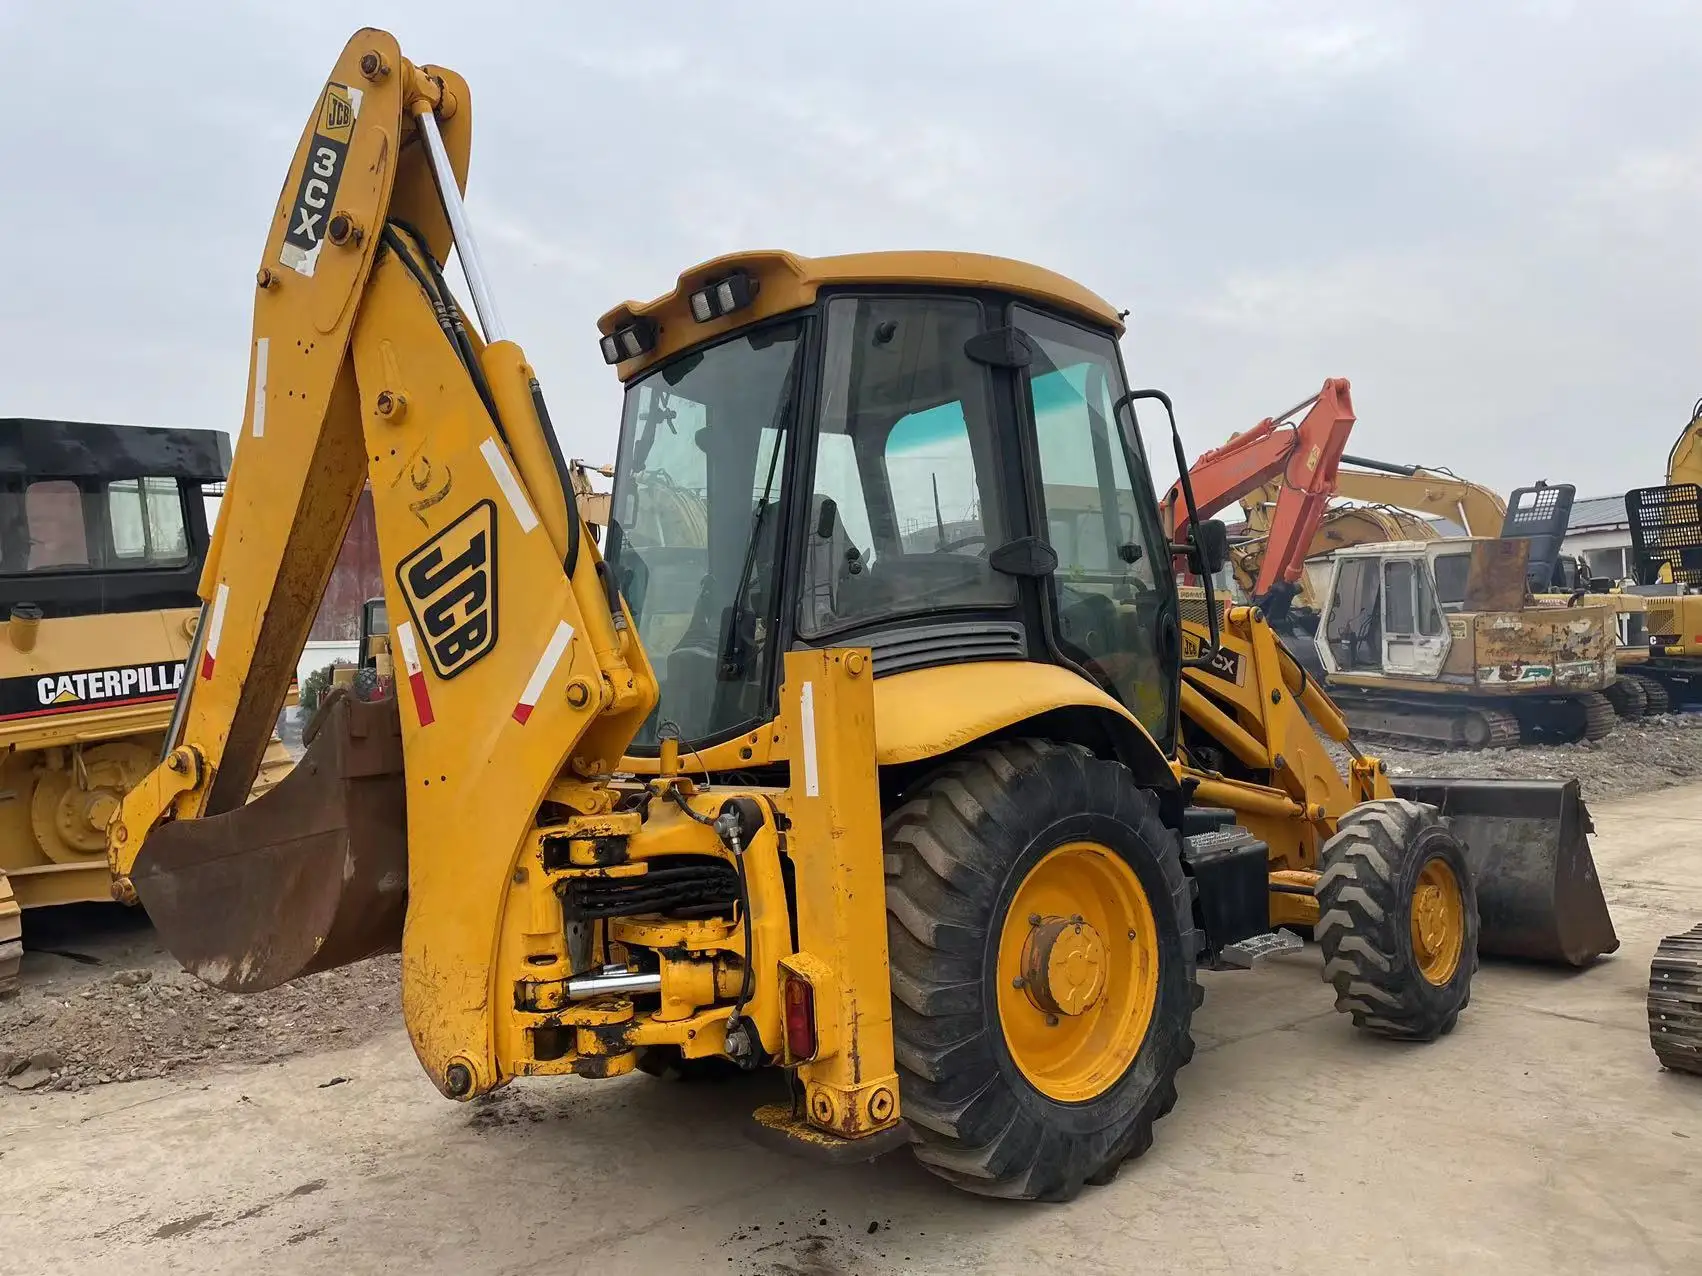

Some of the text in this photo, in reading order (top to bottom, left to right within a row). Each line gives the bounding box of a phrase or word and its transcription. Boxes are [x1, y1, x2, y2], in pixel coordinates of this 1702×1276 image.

[328, 98, 350, 126] JCB
[293, 147, 337, 241] 3CX
[408, 529, 487, 668] JCB
